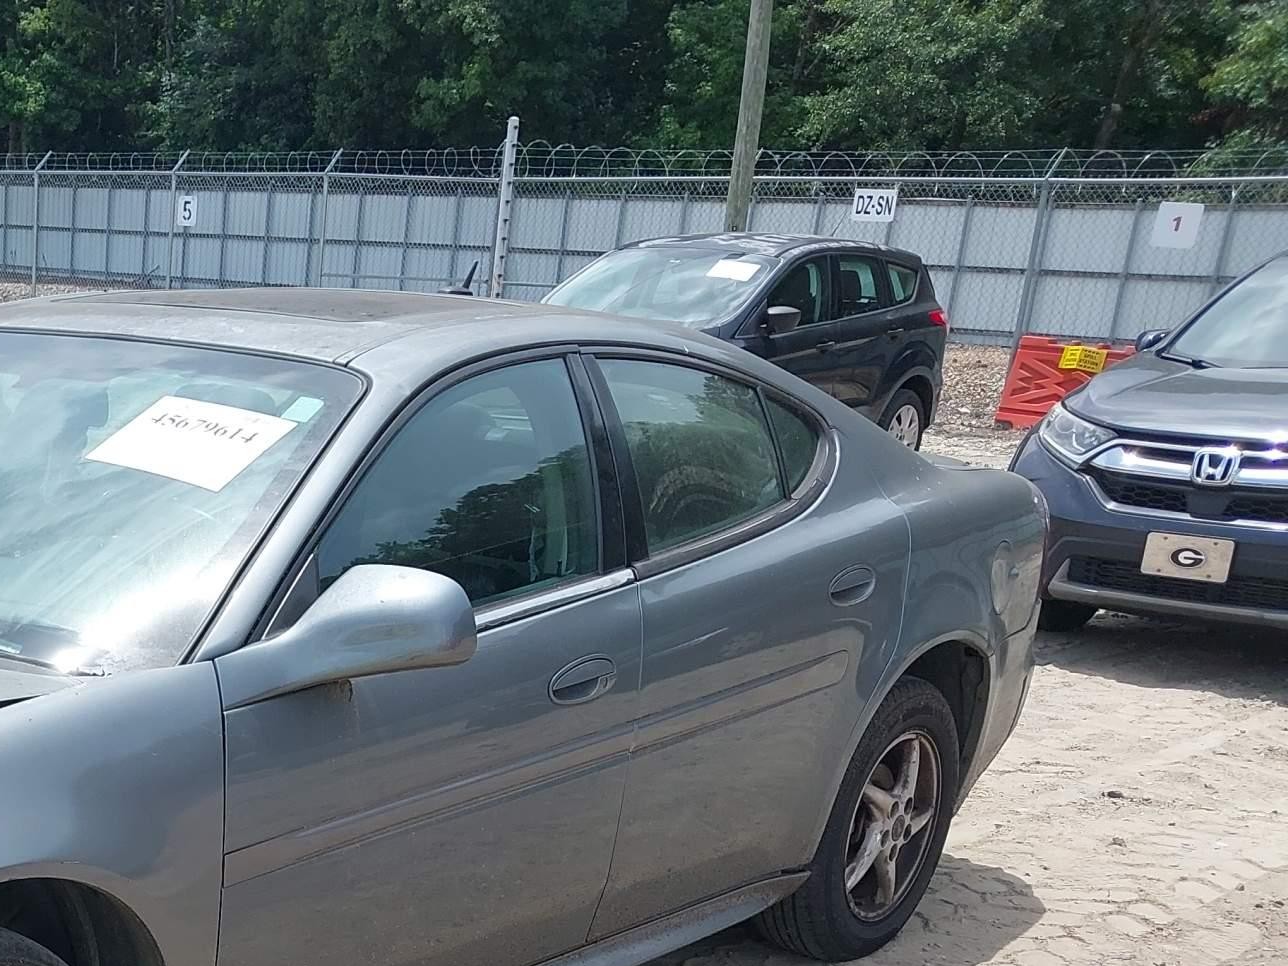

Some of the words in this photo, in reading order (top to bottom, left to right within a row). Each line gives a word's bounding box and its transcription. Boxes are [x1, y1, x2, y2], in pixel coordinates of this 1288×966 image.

[182, 200, 192, 221] 5
[855, 195, 894, 216] DZ-SN
[1172, 215, 1183, 232] 1
[152, 412, 260, 444] 45679614
